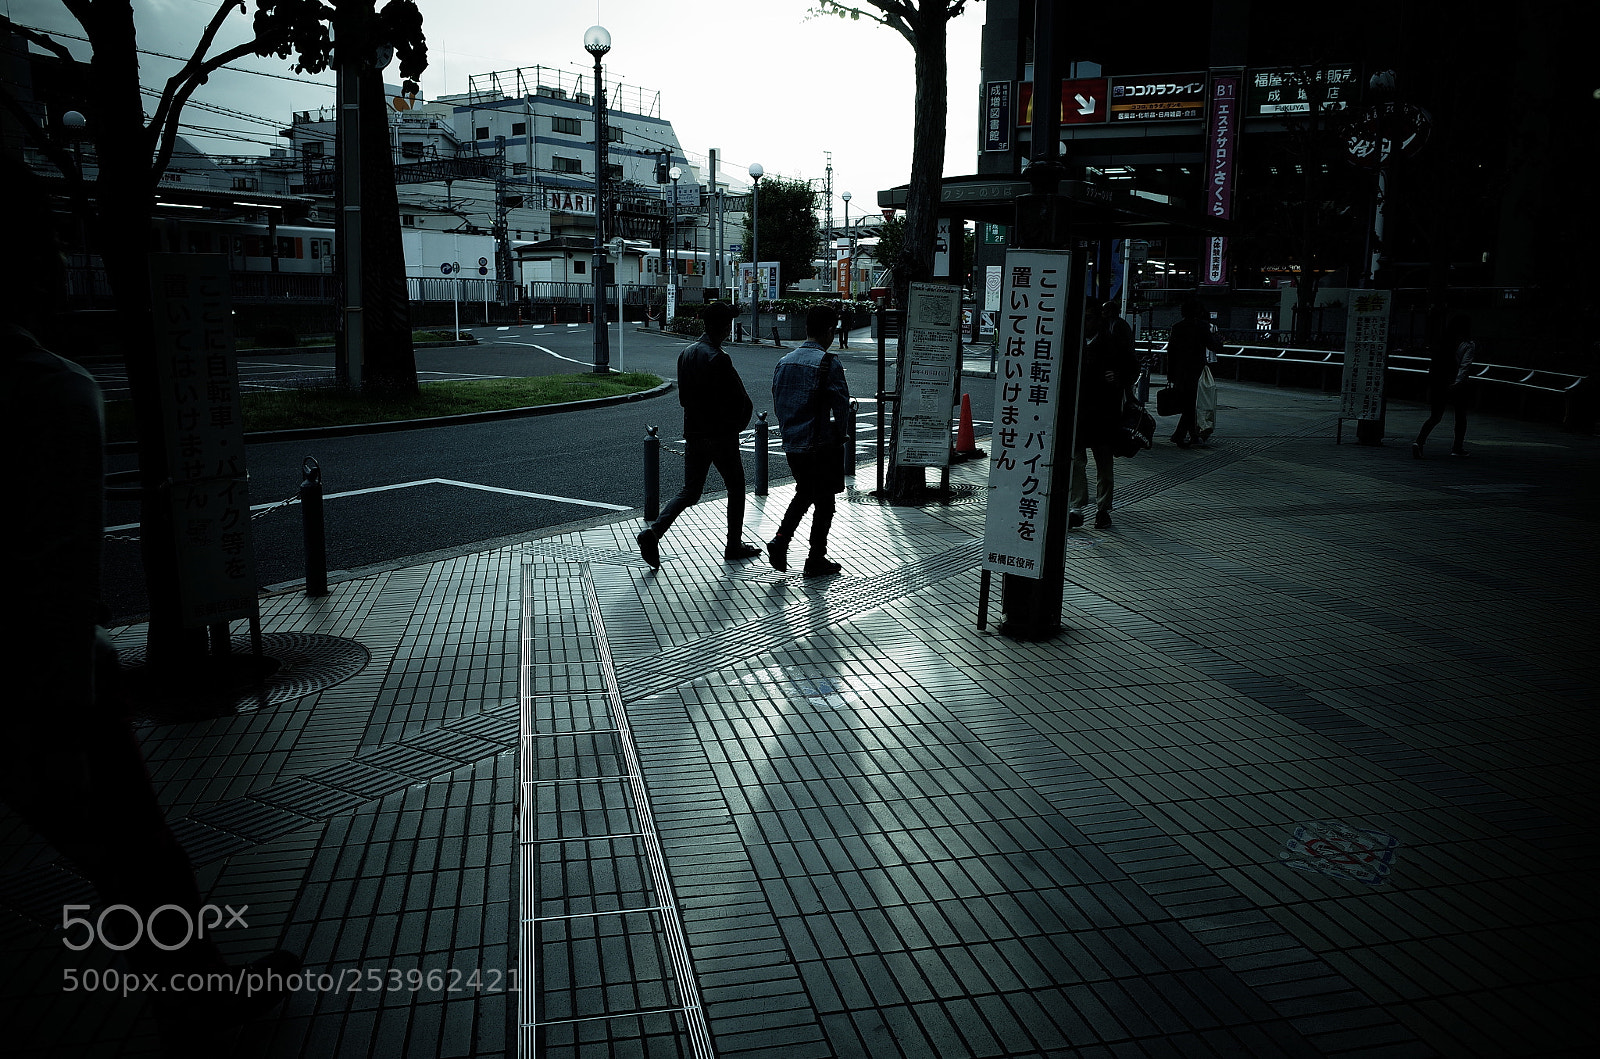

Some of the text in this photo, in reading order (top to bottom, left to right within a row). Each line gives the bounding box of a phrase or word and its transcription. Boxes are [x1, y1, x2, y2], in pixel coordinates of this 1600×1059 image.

[1124, 82, 1204, 97] ココカラファイン
[1216, 84, 1233, 97] B1
[988, 84, 1001, 142] 成増図書館
[1274, 104, 1305, 112] FUKUYA
[1213, 104, 1231, 216] エステサロンさくら
[943, 187, 1013, 199] クシーのりば
[994, 235, 1004, 243] 2F
[996, 266, 1032, 471] 置いてはいけません
[1018, 268, 1058, 541] ここに自転車・バイク等を
[988, 552, 1035, 570] 板橋区役所
